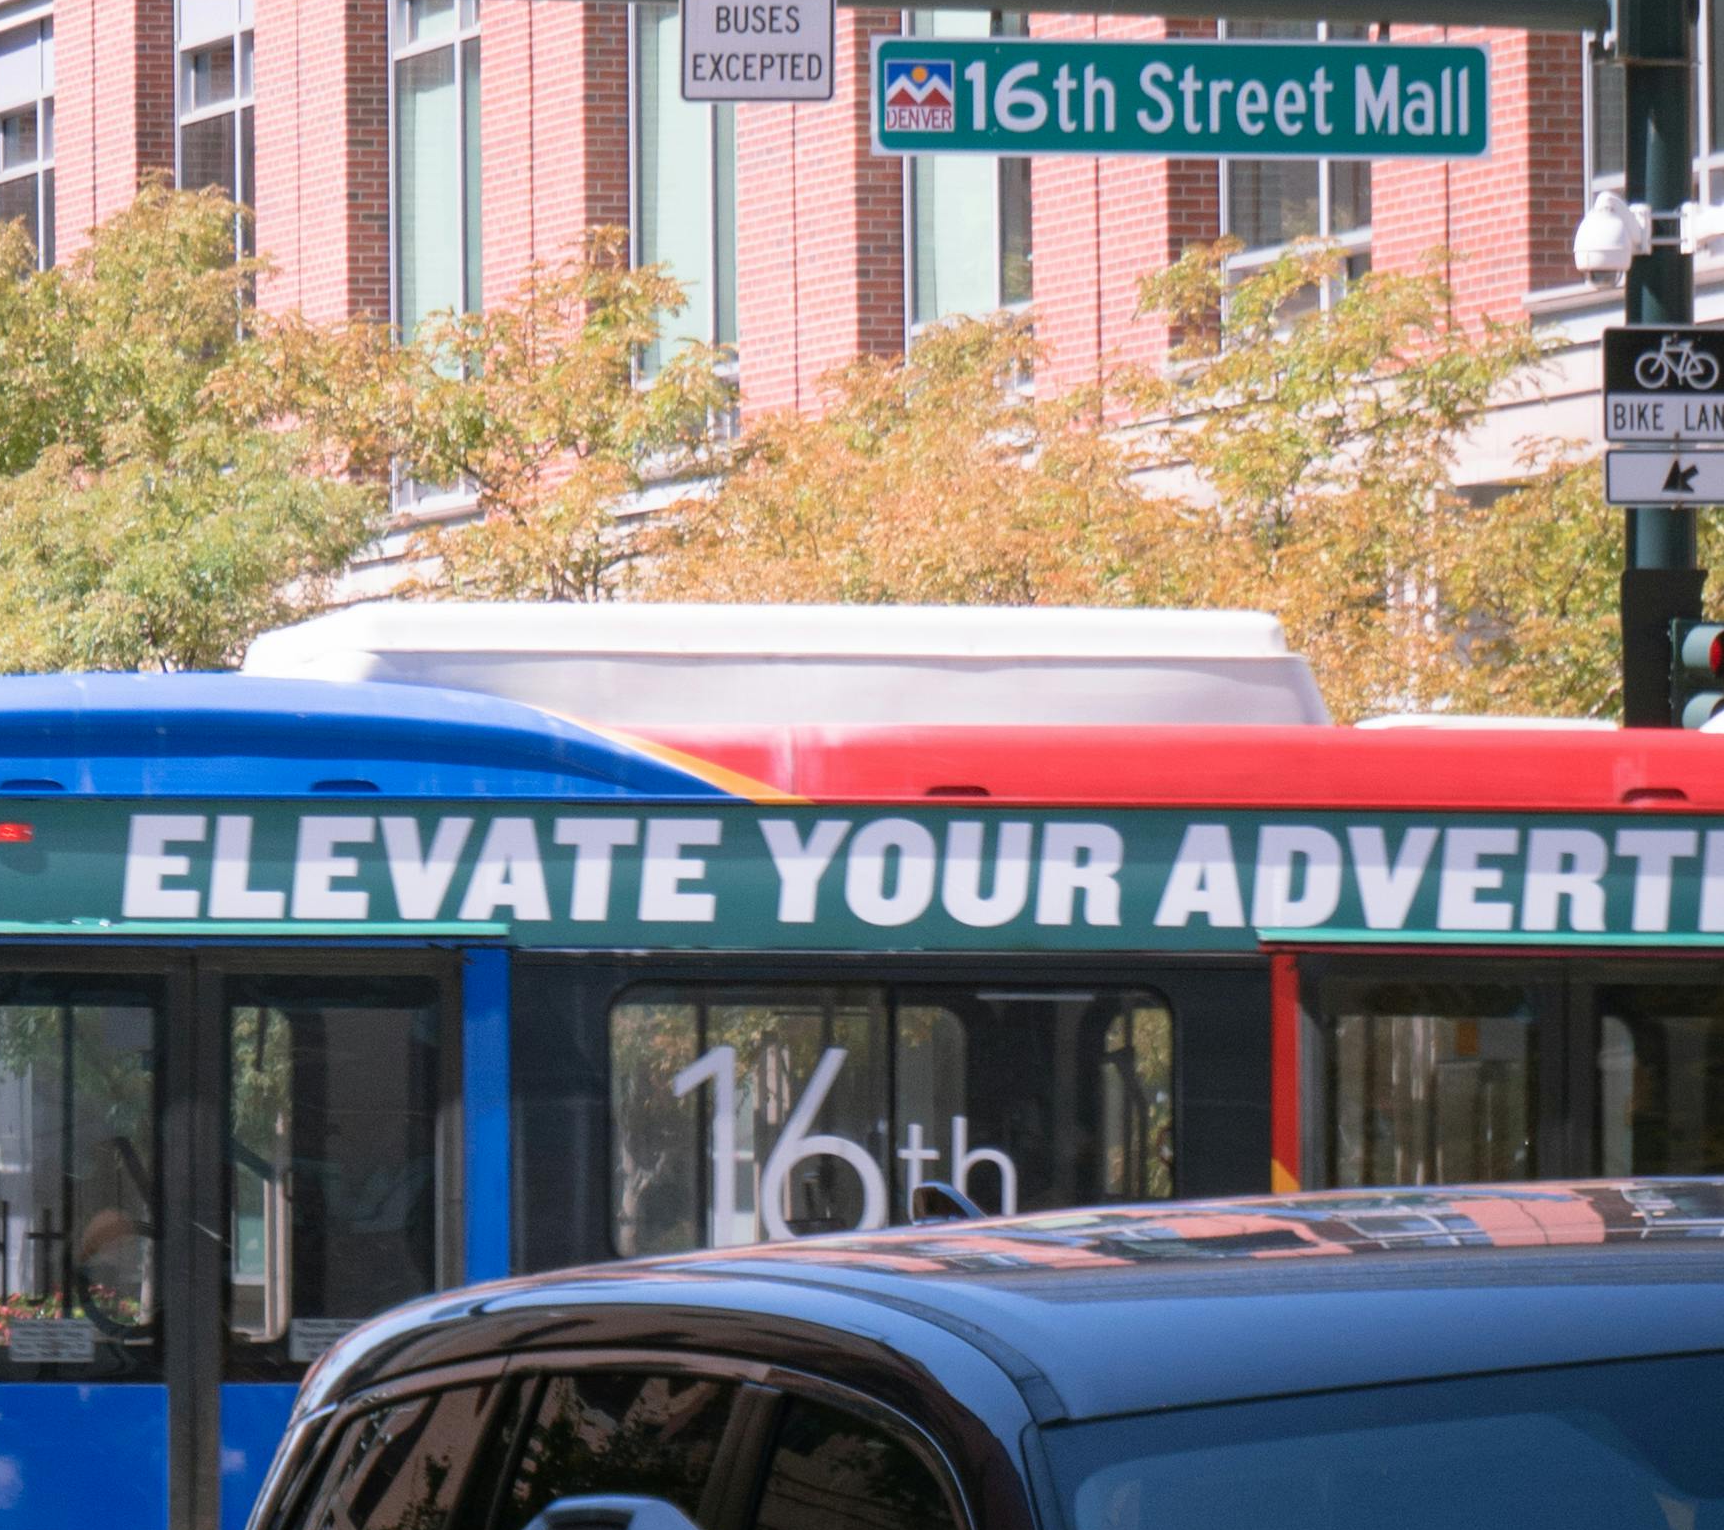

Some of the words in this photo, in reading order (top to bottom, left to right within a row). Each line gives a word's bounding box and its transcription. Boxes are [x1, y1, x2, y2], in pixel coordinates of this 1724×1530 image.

[715, 5, 800, 34] BUSES
[692, 53, 822, 82] EXCEPTED
[964, 60, 1116, 133] 16th
[1135, 63, 1334, 136] Street
[1354, 65, 1472, 137] Mall
[886, 109, 952, 129] DENVER
[1613, 402, 1665, 431] BIKE
[122, 813, 722, 922] ELEVATE
[759, 818, 1125, 928] YOUR
[672, 1046, 1017, 1247] 16th
